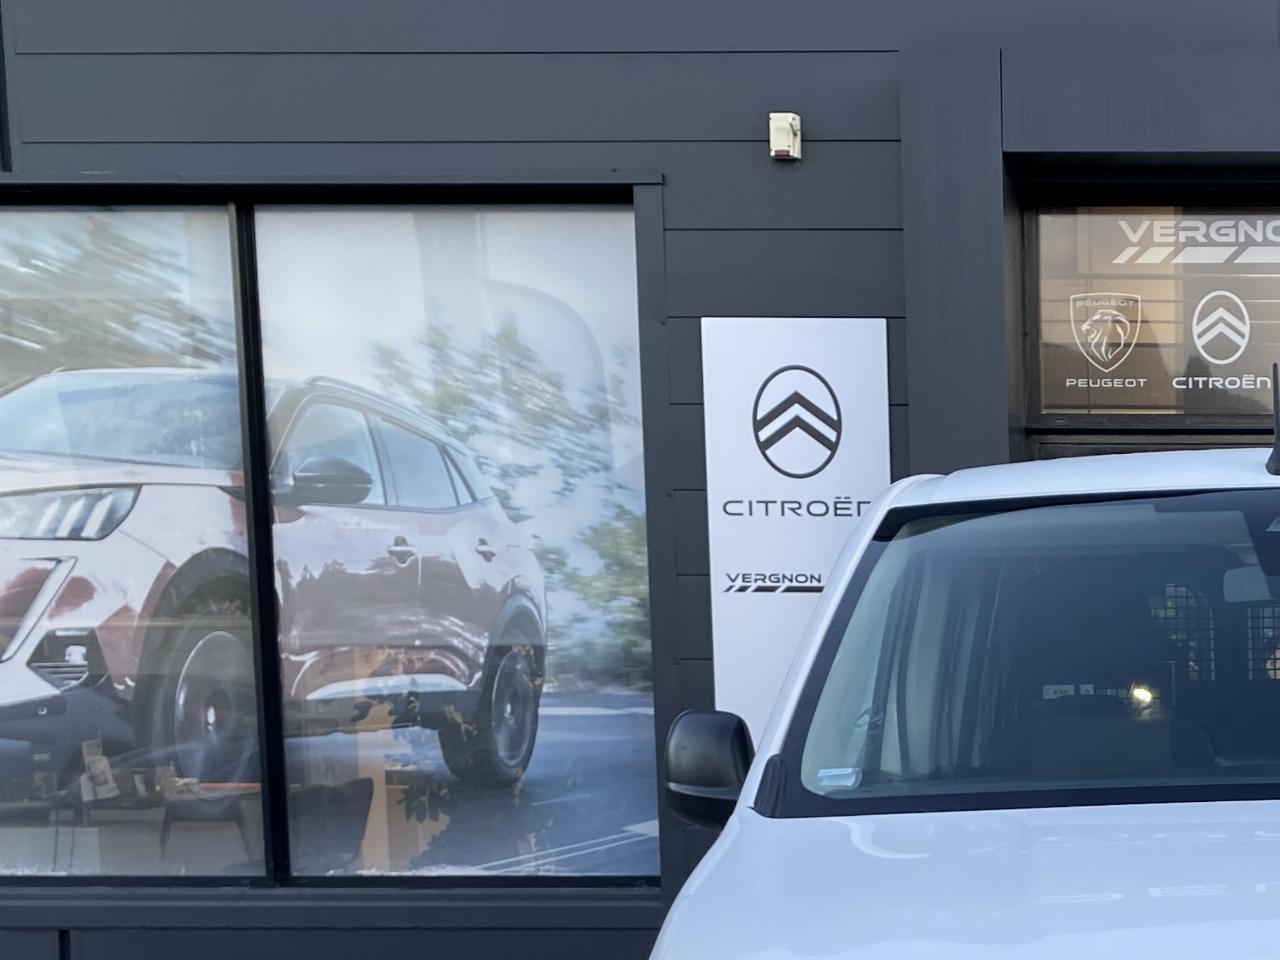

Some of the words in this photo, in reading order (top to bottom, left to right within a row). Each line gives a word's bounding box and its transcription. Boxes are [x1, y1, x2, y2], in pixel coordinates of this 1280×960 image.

[1076, 298, 1135, 307] PEUGEOT
[1065, 377, 1148, 388] PEUGEOT
[725, 572, 822, 584] VERGNON
